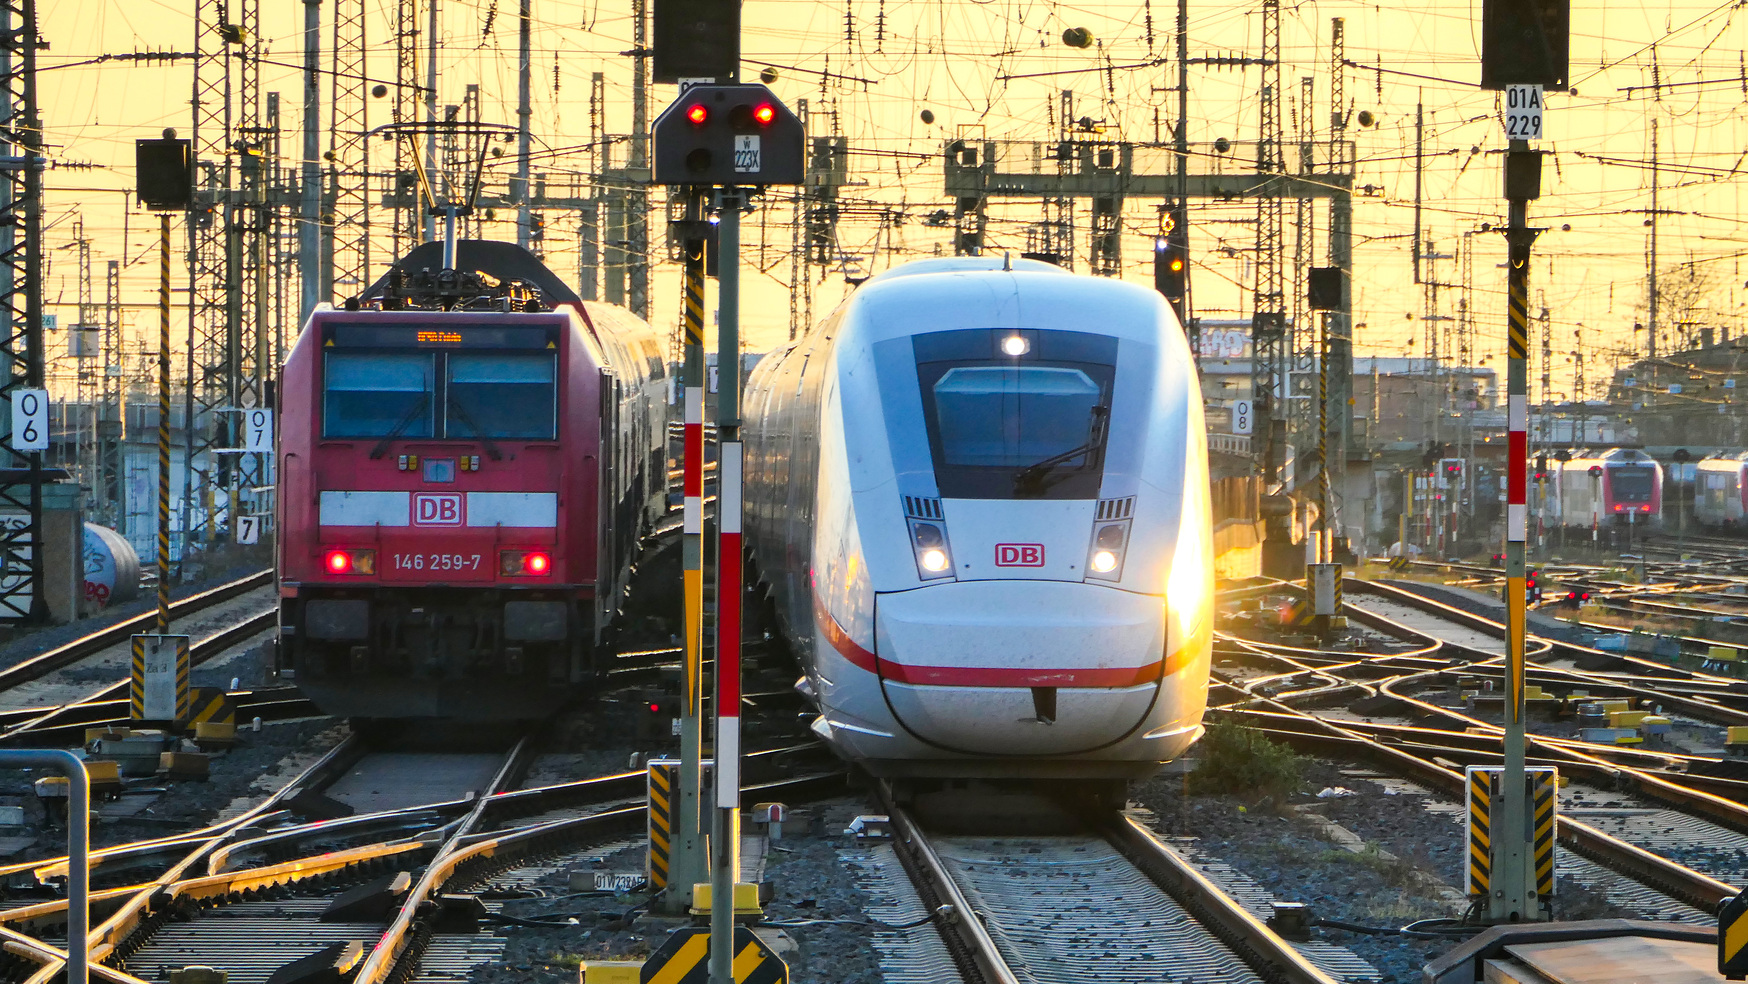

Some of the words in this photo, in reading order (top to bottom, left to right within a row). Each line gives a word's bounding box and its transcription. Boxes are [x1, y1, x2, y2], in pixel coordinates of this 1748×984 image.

[1509, 88, 1540, 108] 01A
[1509, 115, 1540, 135] 229
[743, 140, 750, 149] W
[735, 150, 758, 168] 223X
[21, 394, 38, 416] 0
[1238, 402, 1248, 415] 0
[253, 411, 265, 427] 0
[1239, 416, 1246, 429] 8
[23, 420, 38, 442] 6
[254, 429, 263, 446] 7
[420, 498, 457, 520] DB
[243, 519, 253, 540] 7
[394, 554, 423, 569] 146
[430, 554, 481, 570] 259-7
[1001, 547, 1039, 563] DB
